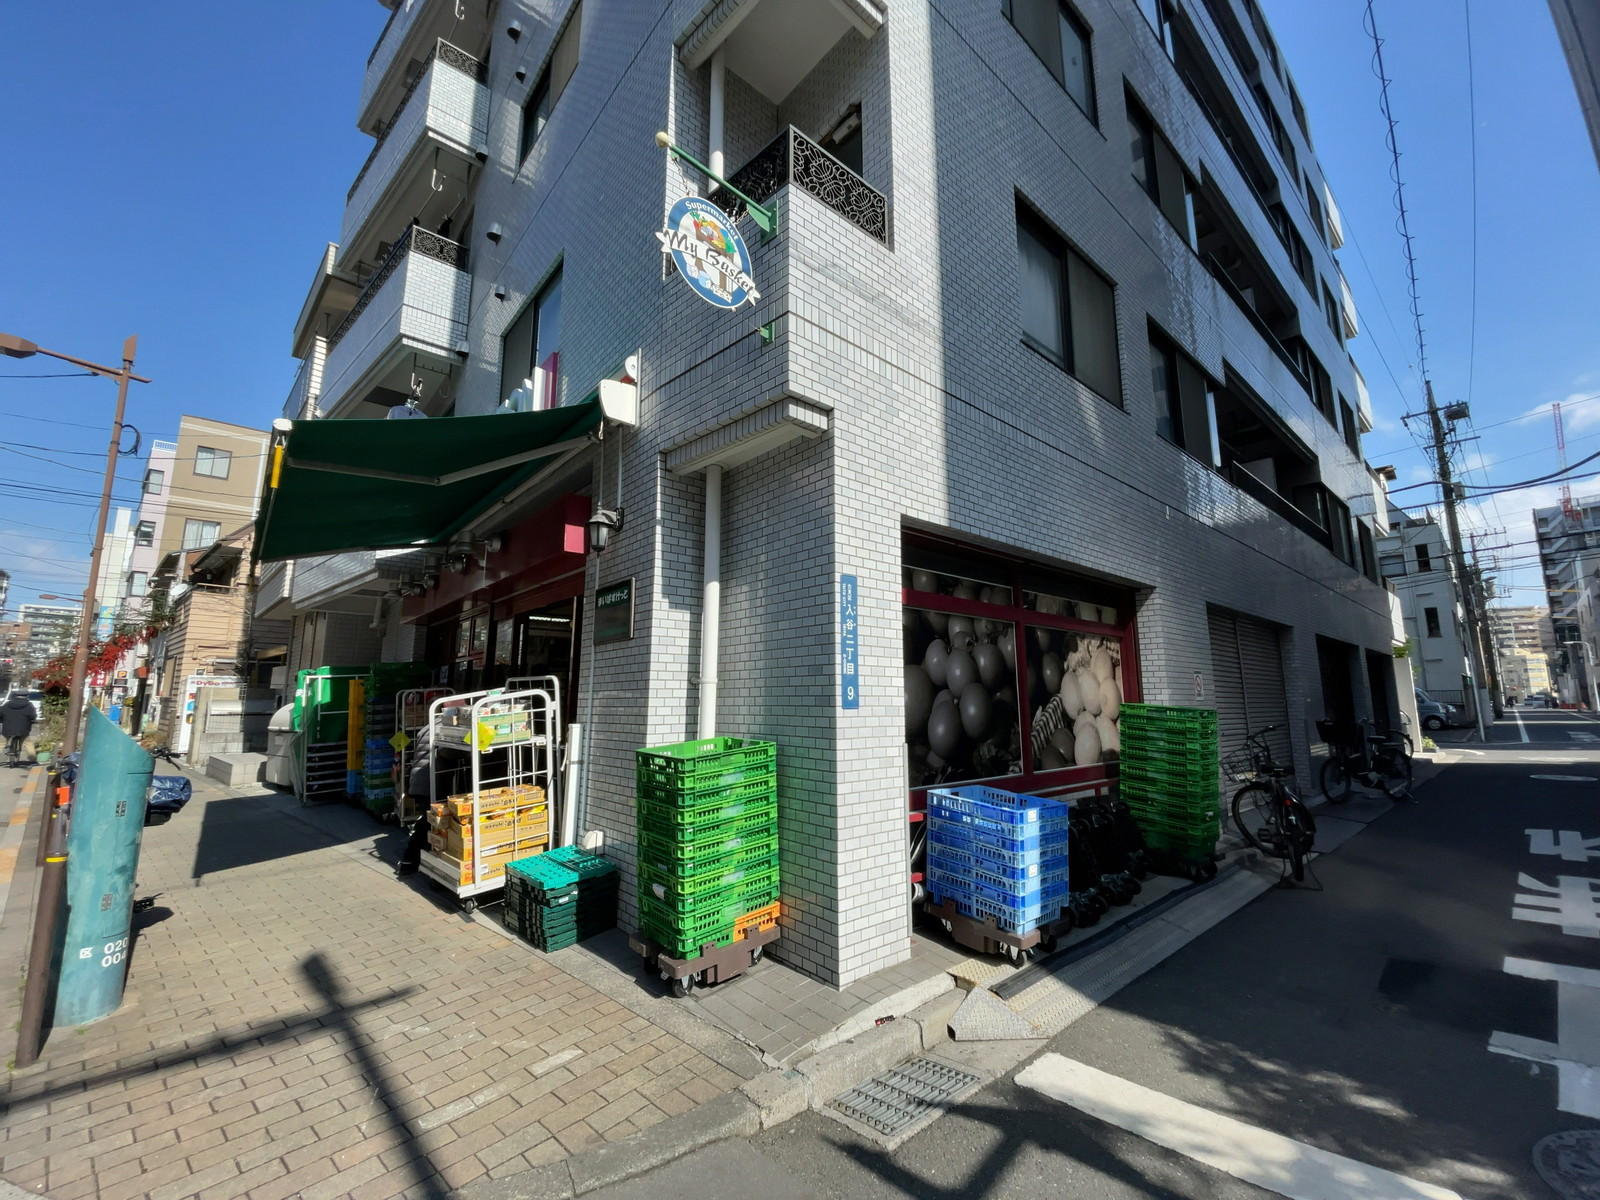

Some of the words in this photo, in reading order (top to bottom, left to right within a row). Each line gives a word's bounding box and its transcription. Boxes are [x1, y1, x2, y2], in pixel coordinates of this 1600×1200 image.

[685, 200, 739, 241] Supermarket
[663, 229, 698, 258] My
[705, 249, 754, 295] Basket
[598, 590, 628, 606] まいばすけっと
[846, 604, 855, 675] 入谷二丁目
[847, 686, 854, 700] 9
